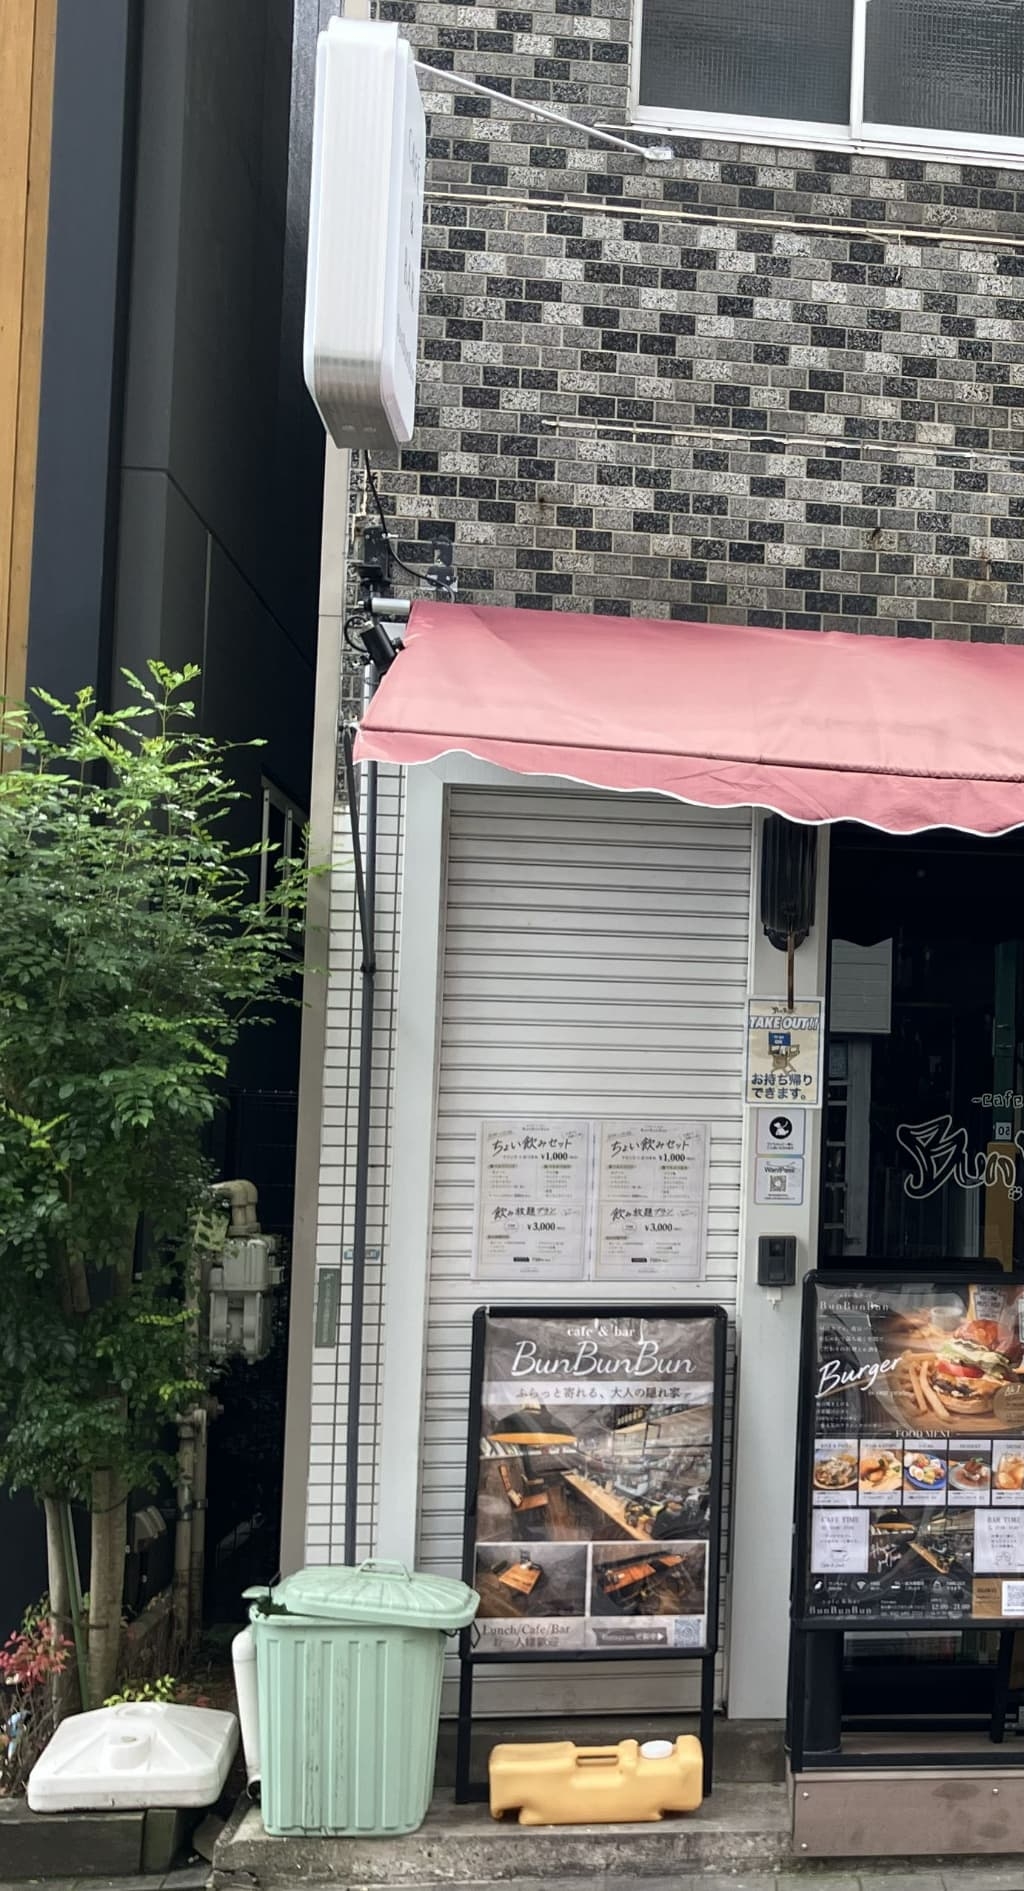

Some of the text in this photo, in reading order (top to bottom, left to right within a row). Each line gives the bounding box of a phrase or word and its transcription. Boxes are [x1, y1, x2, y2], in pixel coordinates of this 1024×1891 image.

[750, 1016, 781, 1030] TAKE
[752, 1073, 813, 1086] お持ち帰り
[752, 1087, 806, 1100] できます。
[492, 1136, 573, 1157] ちょい飲みセット
[610, 1137, 690, 1158] ちょい飲みセット
[491, 1205, 557, 1221] 飲み放題プラン
[610, 1207, 674, 1221] 飲み放題プラン
[614, 1325, 636, 1337] bar
[511, 1340, 697, 1377] BunBunBun
[814, 1357, 903, 1399] Burger
[895, 1429, 923, 1438] FOOD
[482, 1623, 570, 1636] Lunch/Cafe/Bar
